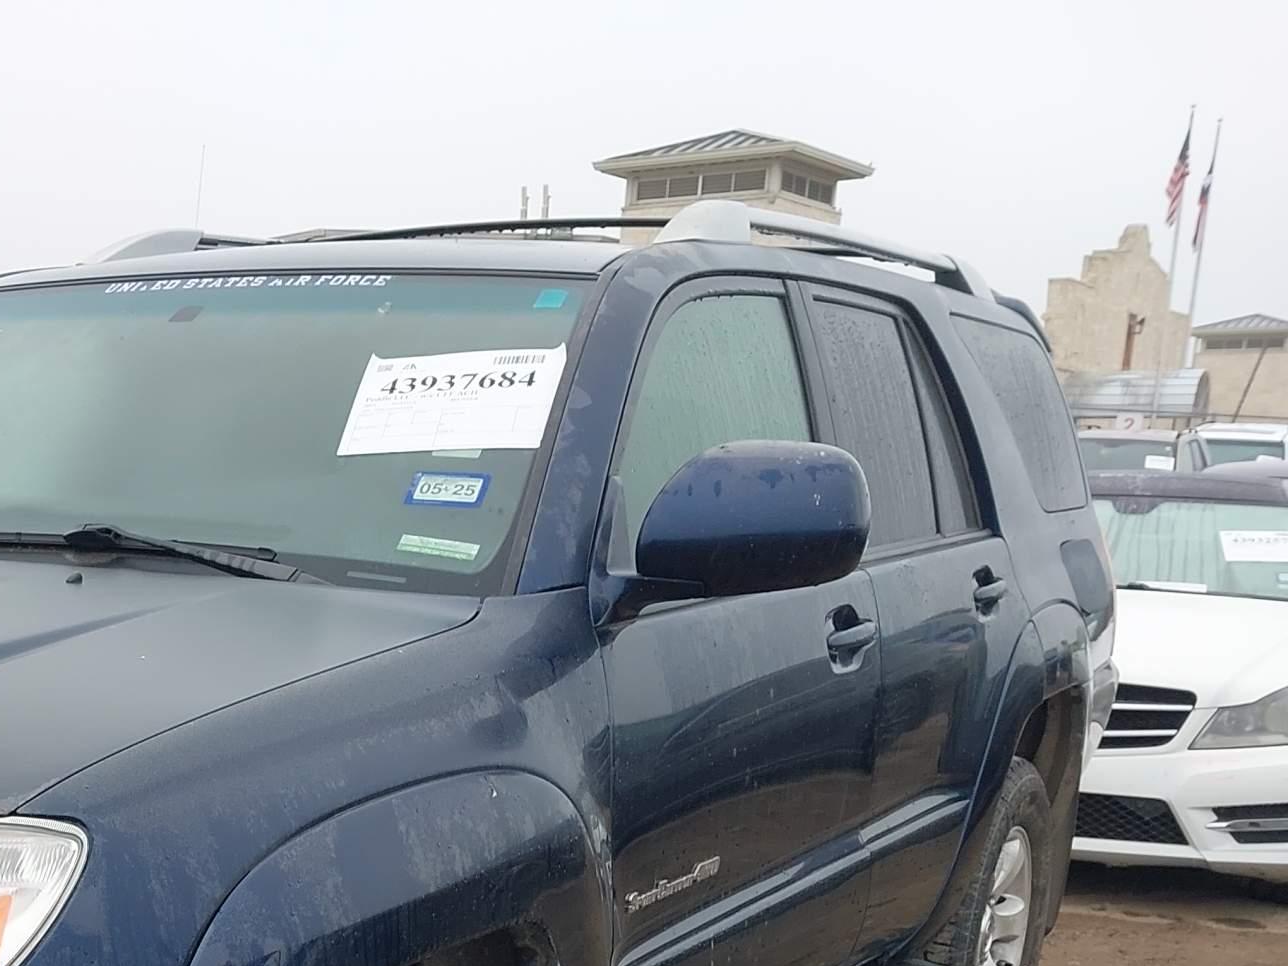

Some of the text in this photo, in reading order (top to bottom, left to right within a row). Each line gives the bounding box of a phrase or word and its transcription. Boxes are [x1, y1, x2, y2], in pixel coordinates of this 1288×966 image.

[183, 276, 267, 288] STATES
[314, 274, 393, 287] FORCE
[380, 370, 536, 395] 43937684
[419, 482, 477, 496] 05 25
